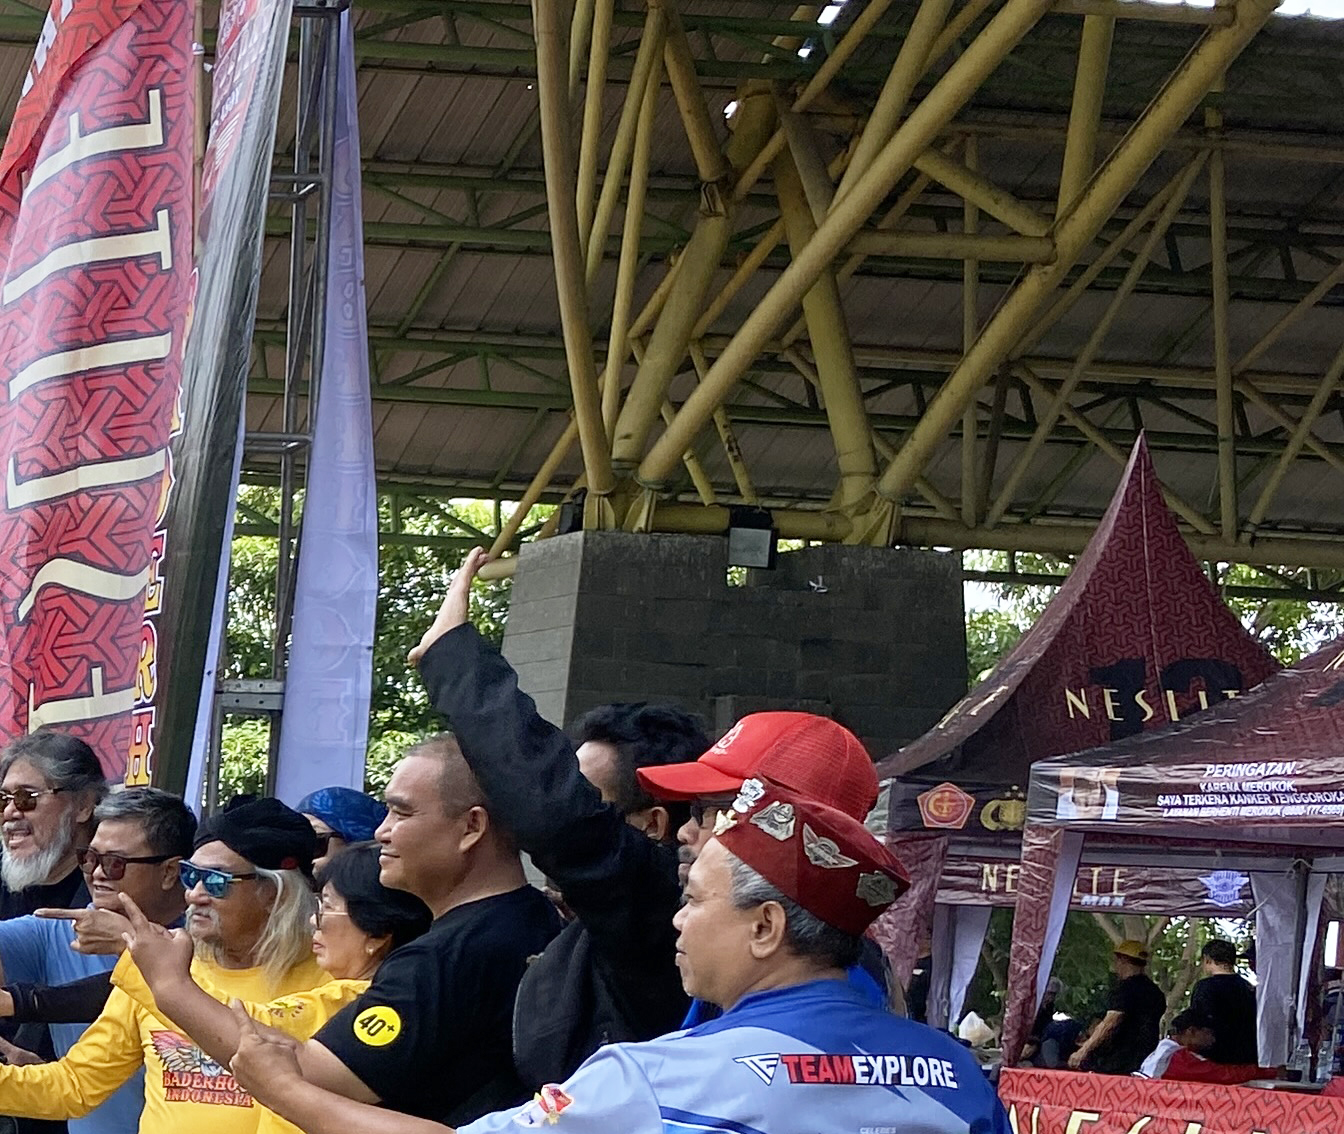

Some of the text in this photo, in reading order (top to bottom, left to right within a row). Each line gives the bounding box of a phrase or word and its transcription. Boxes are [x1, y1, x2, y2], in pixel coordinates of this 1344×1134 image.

[1200, 782, 1240, 793] KARENA
[1157, 791, 1344, 806] SAYA TERKENA KANKER TENGGOROKA
[165, 1088, 254, 1108] INDONESIA
